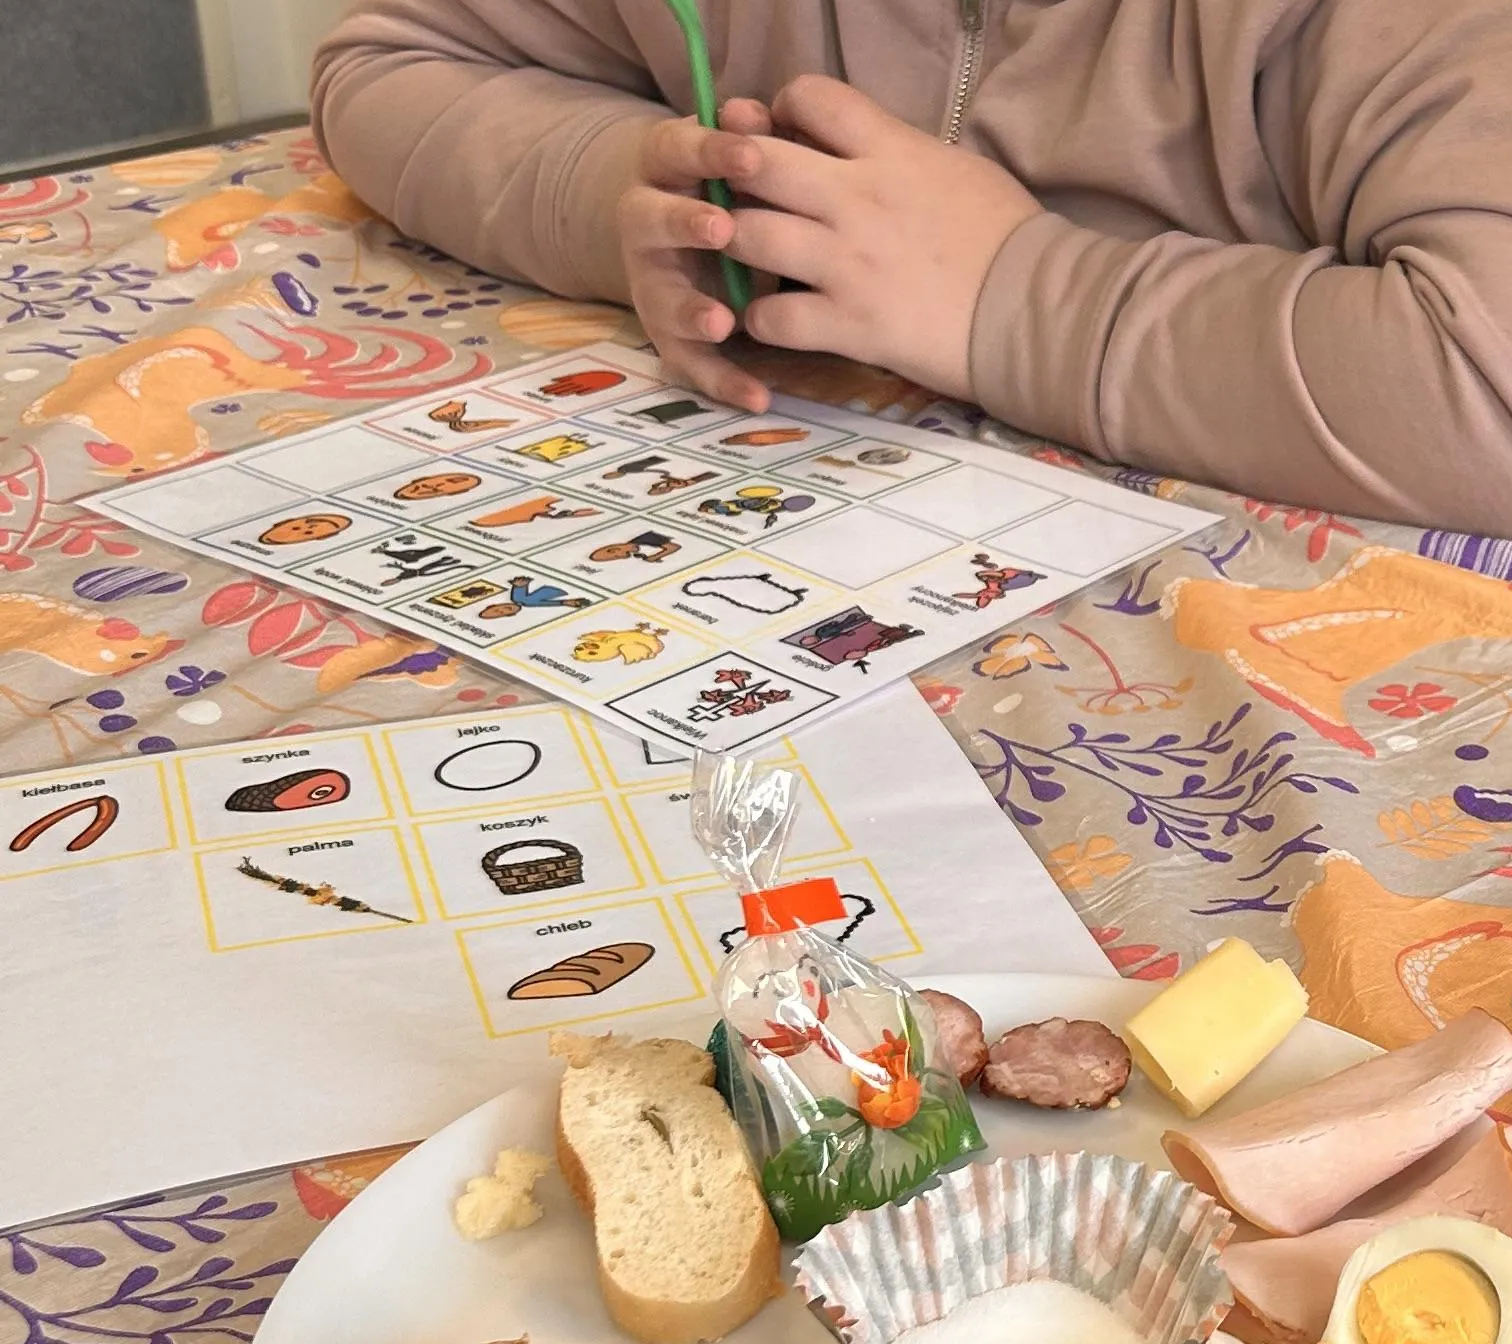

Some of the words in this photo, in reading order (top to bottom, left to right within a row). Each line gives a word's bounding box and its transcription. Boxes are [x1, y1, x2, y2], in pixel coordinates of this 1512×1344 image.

[528, 652, 594, 684] kurczaczek
[457, 723, 500, 739] jajko
[646, 708, 708, 741] Wielkanoc
[241, 747, 311, 765] szynka
[21, 777, 106, 799] kiełbasa
[479, 813, 549, 833] koszyk
[287, 837, 355, 856] palma
[535, 917, 592, 937] chleb
